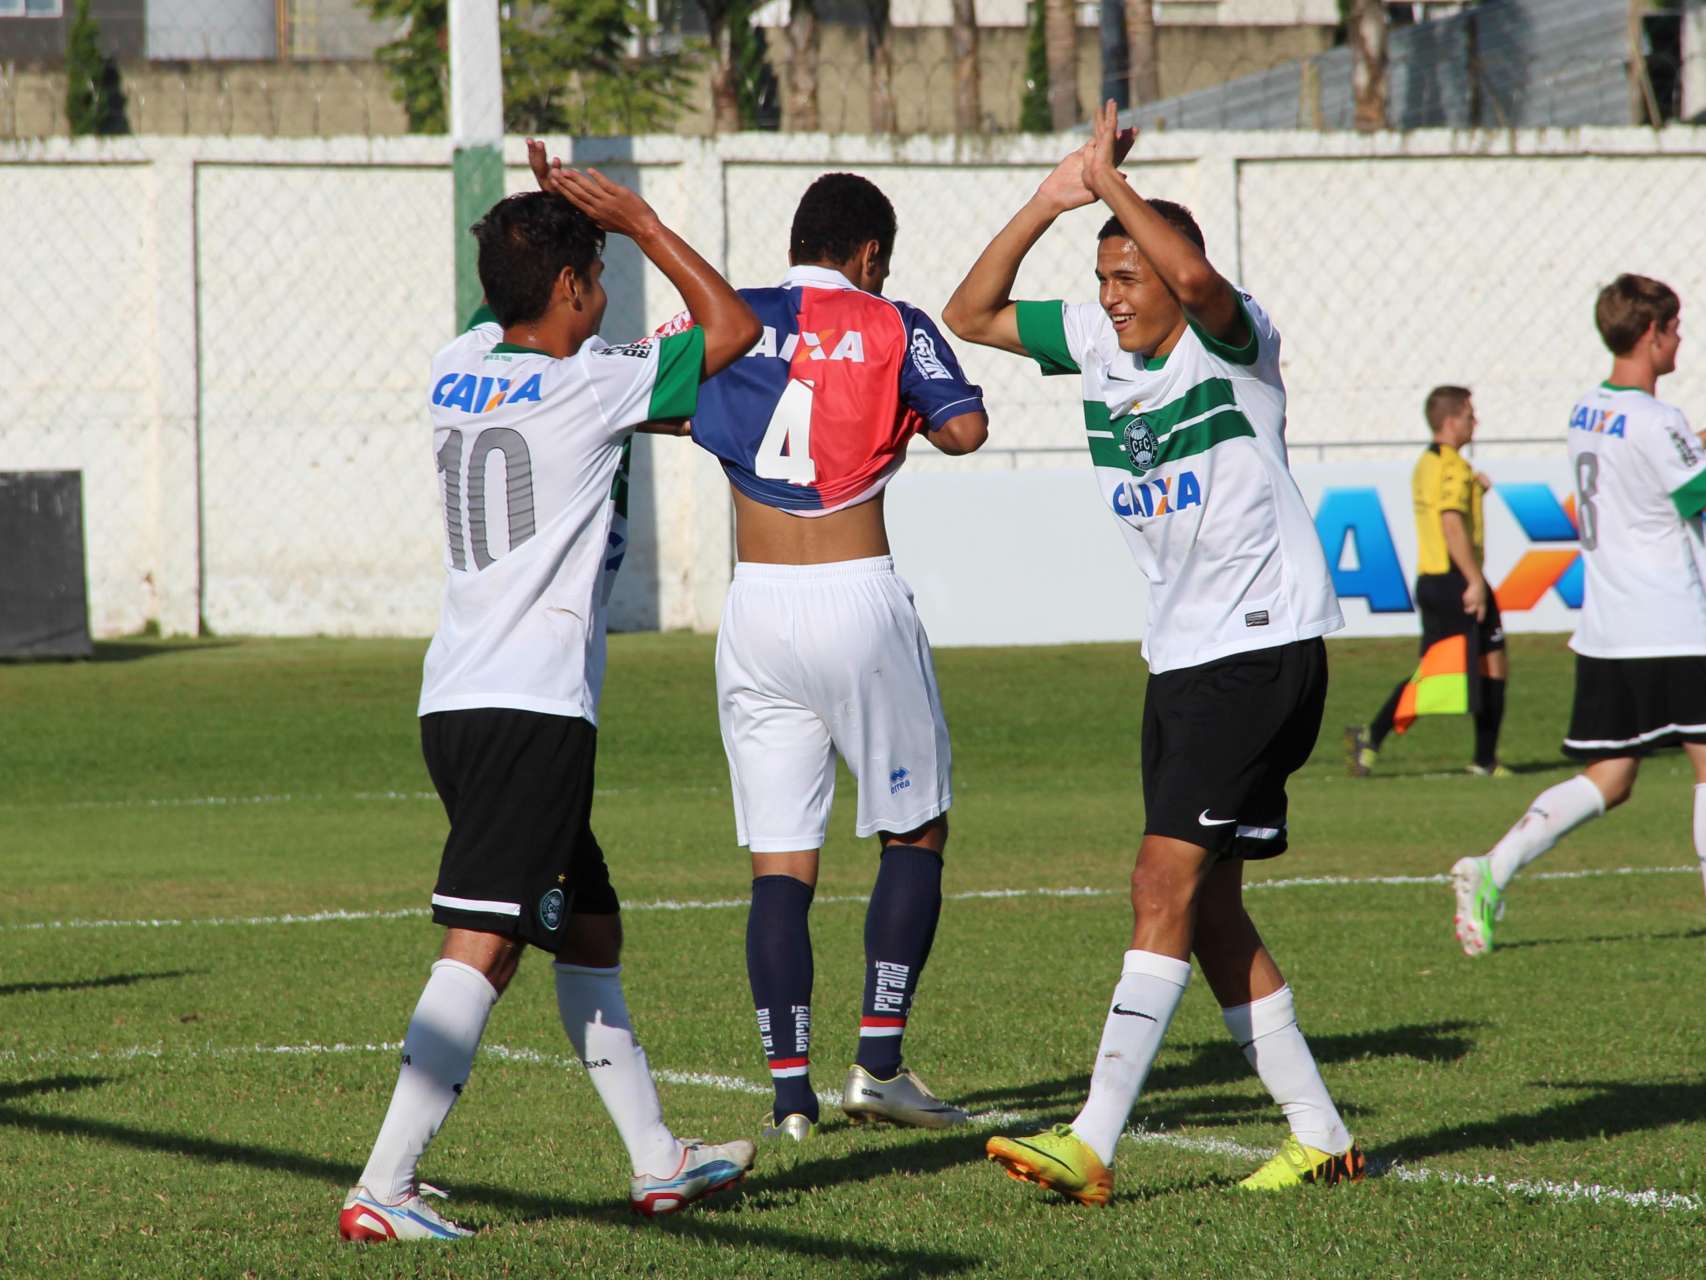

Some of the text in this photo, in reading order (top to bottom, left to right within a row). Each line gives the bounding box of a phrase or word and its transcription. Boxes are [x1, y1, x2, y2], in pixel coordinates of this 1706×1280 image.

[744, 325, 865, 363] AIXA
[432, 373, 543, 414] CAIXA
[755, 378, 816, 487] 4
[1132, 438, 1150, 453] CFC
[437, 427, 536, 572] 10
[1113, 471, 1202, 517] CAIXA
[1576, 451, 1598, 552] 8
